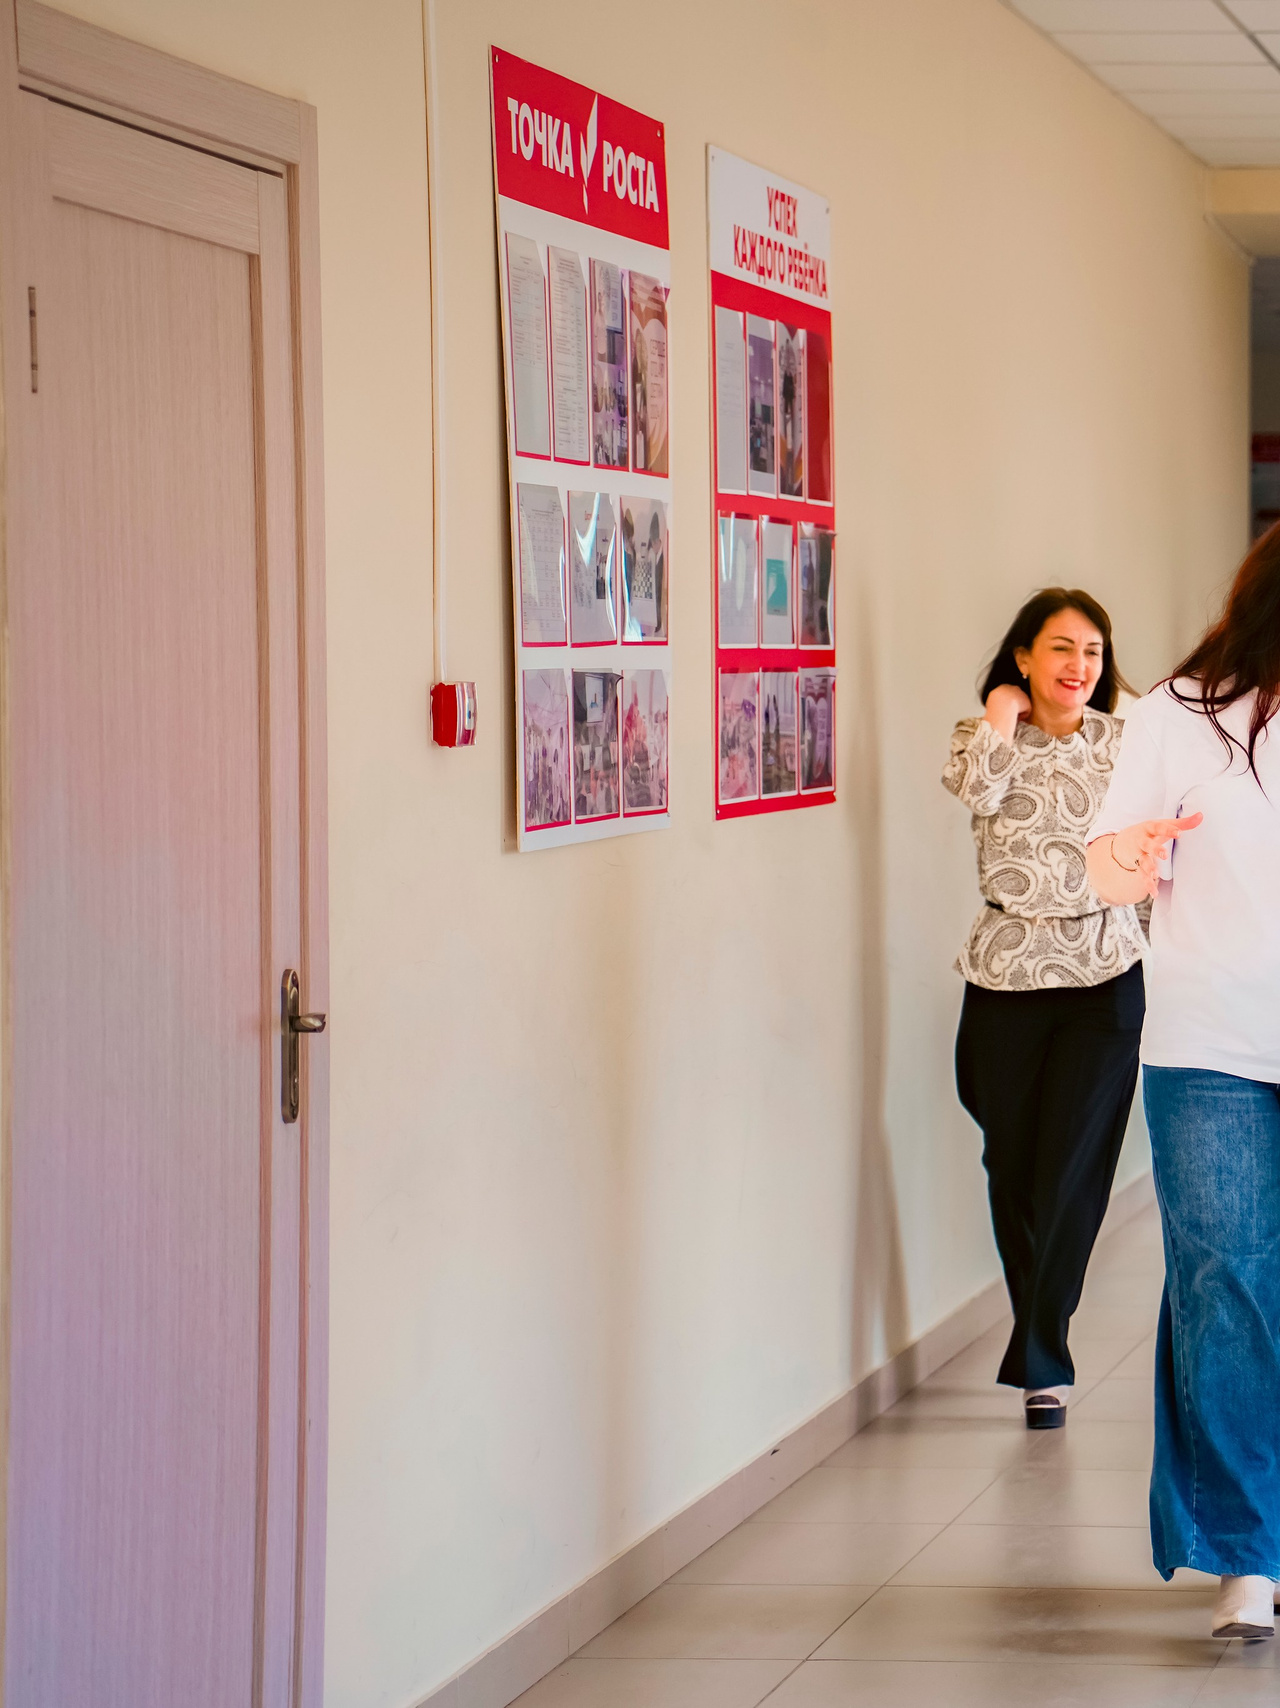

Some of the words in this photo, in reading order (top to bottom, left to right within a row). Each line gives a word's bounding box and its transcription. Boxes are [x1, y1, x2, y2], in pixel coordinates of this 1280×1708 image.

[507, 97, 575, 178] ТОЧКА
[603, 140, 660, 213] РОСТА
[766, 186, 798, 239] УСПЕХ
[733, 224, 786, 285] КАЖДОГО
[787, 242, 828, 299] РЕБЁНКА
